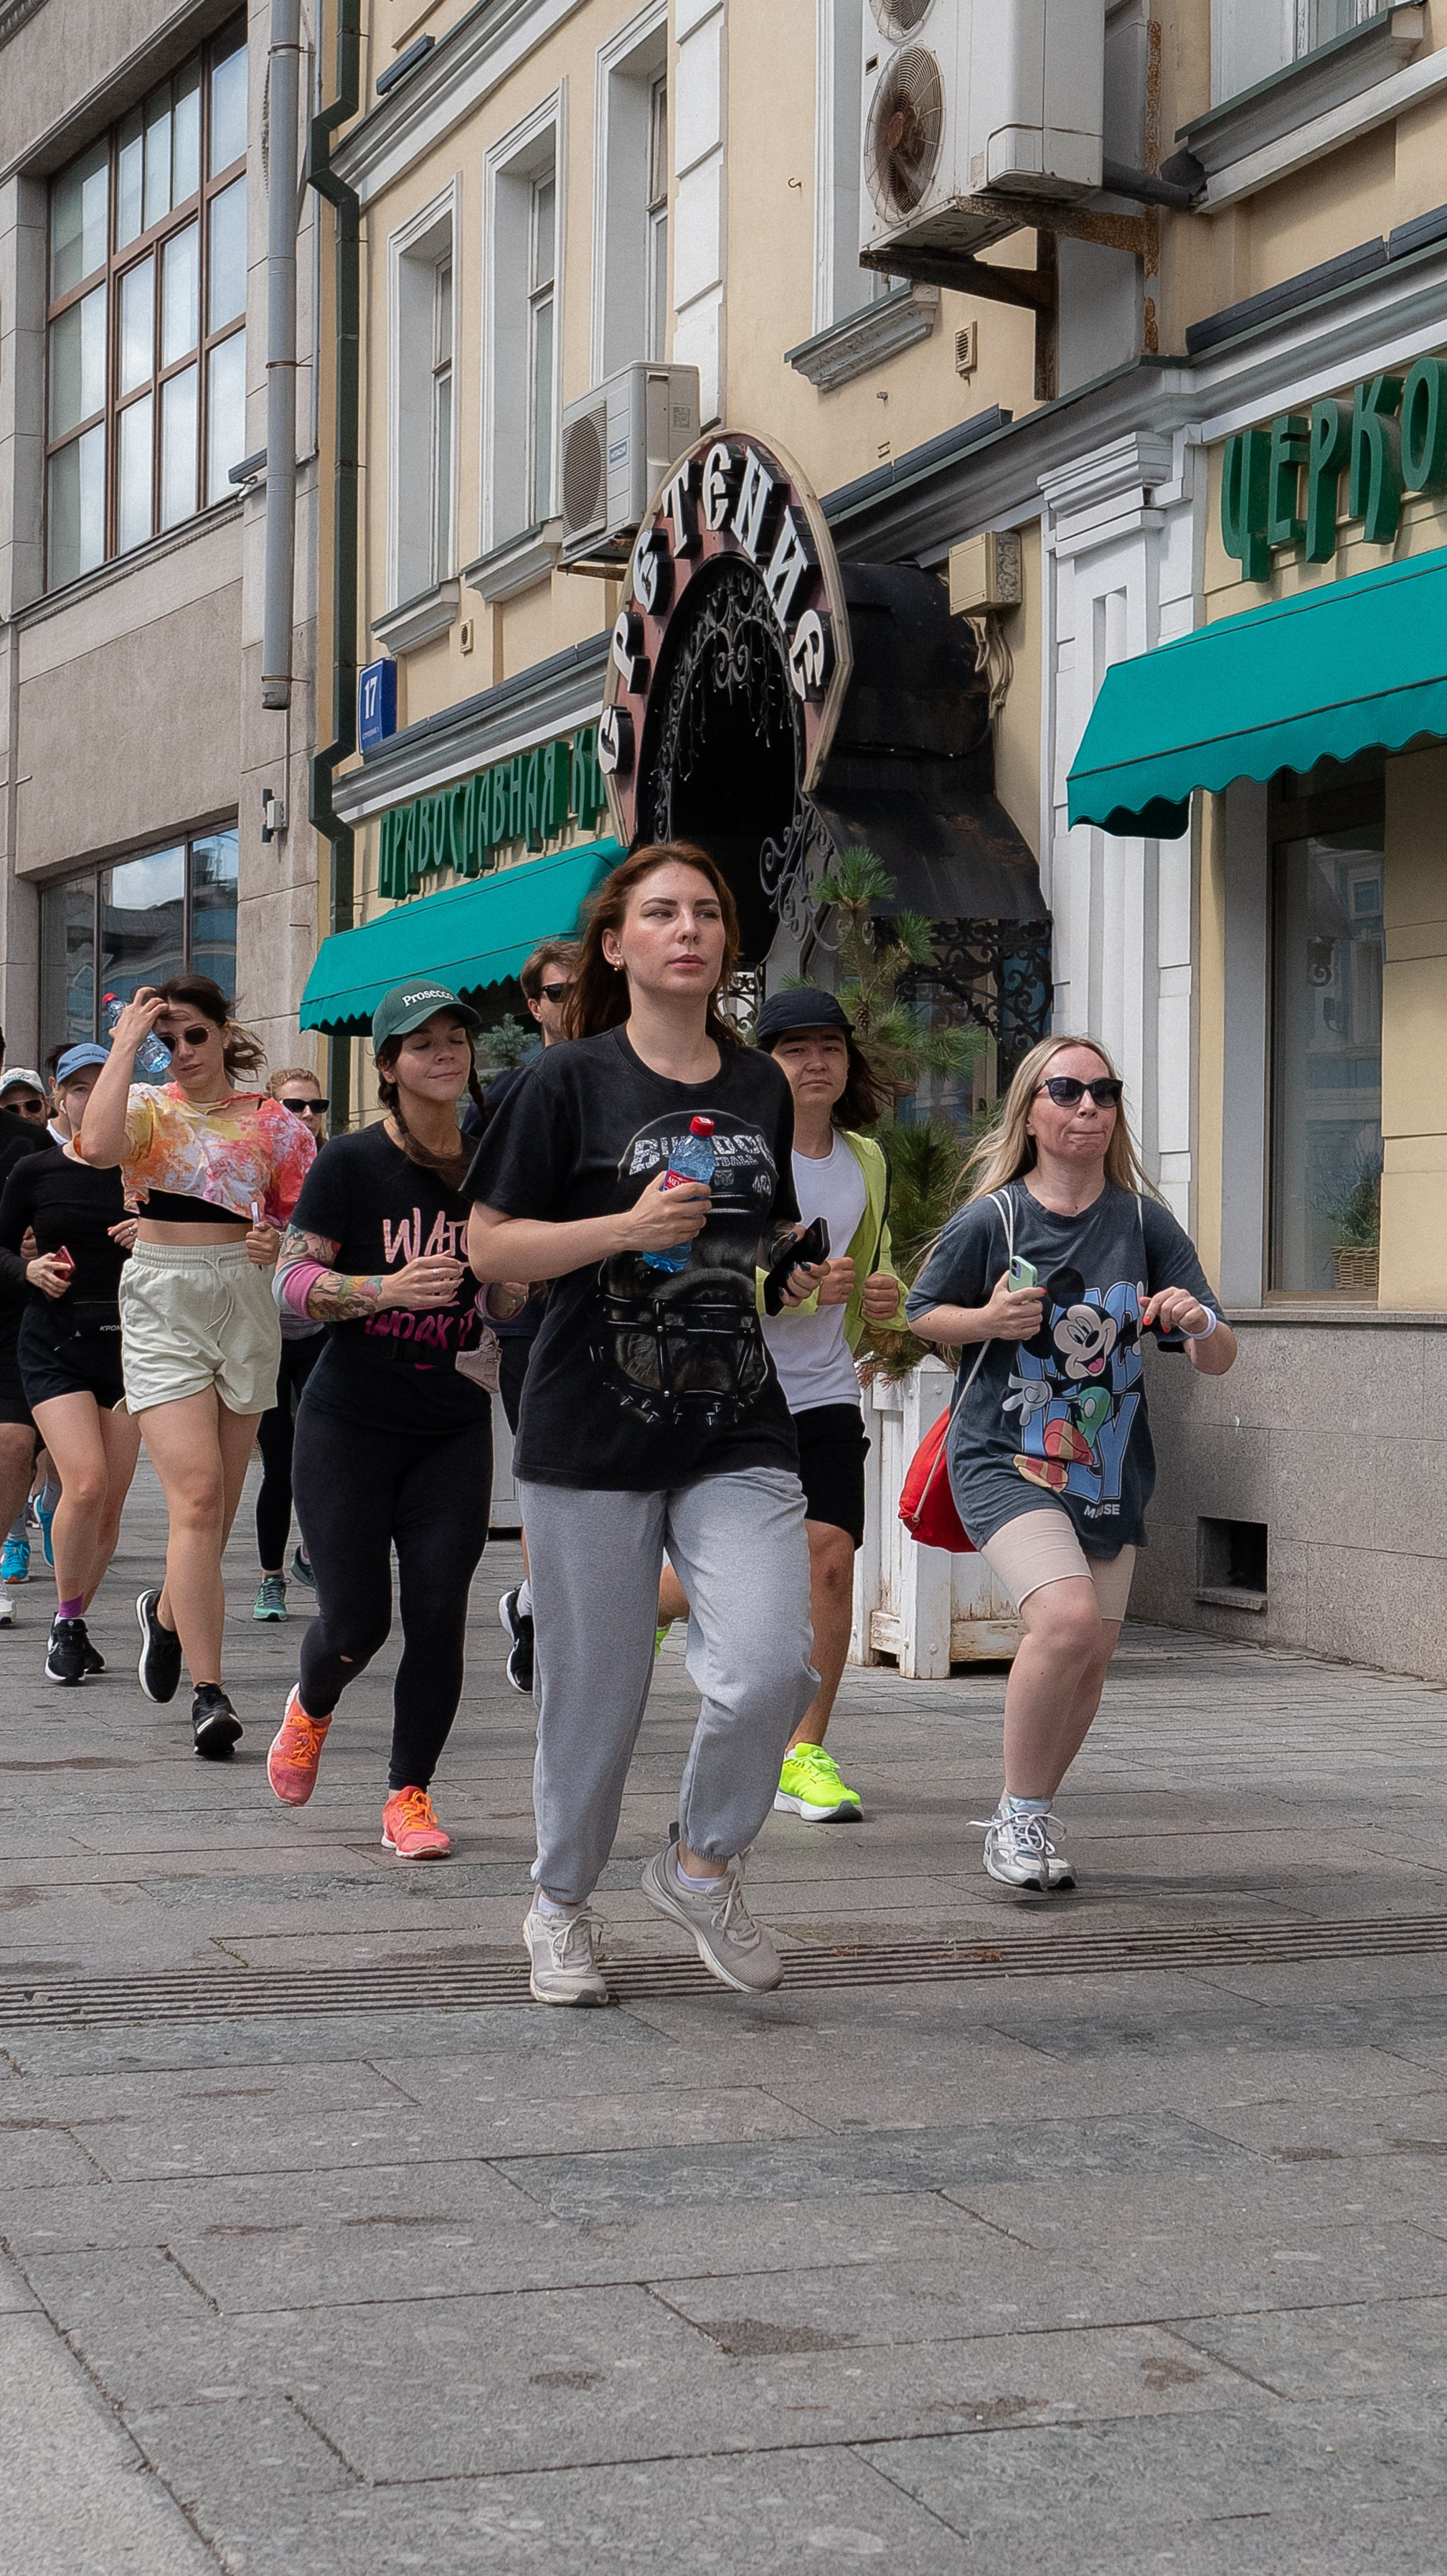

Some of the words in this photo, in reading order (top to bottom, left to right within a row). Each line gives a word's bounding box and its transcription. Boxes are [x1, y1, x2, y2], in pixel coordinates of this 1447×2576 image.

[364, 675, 378, 720] 17
[378, 741, 570, 901] ПРАВОСЛАВНАЯ
[402, 989, 454, 1007] Prosecco
